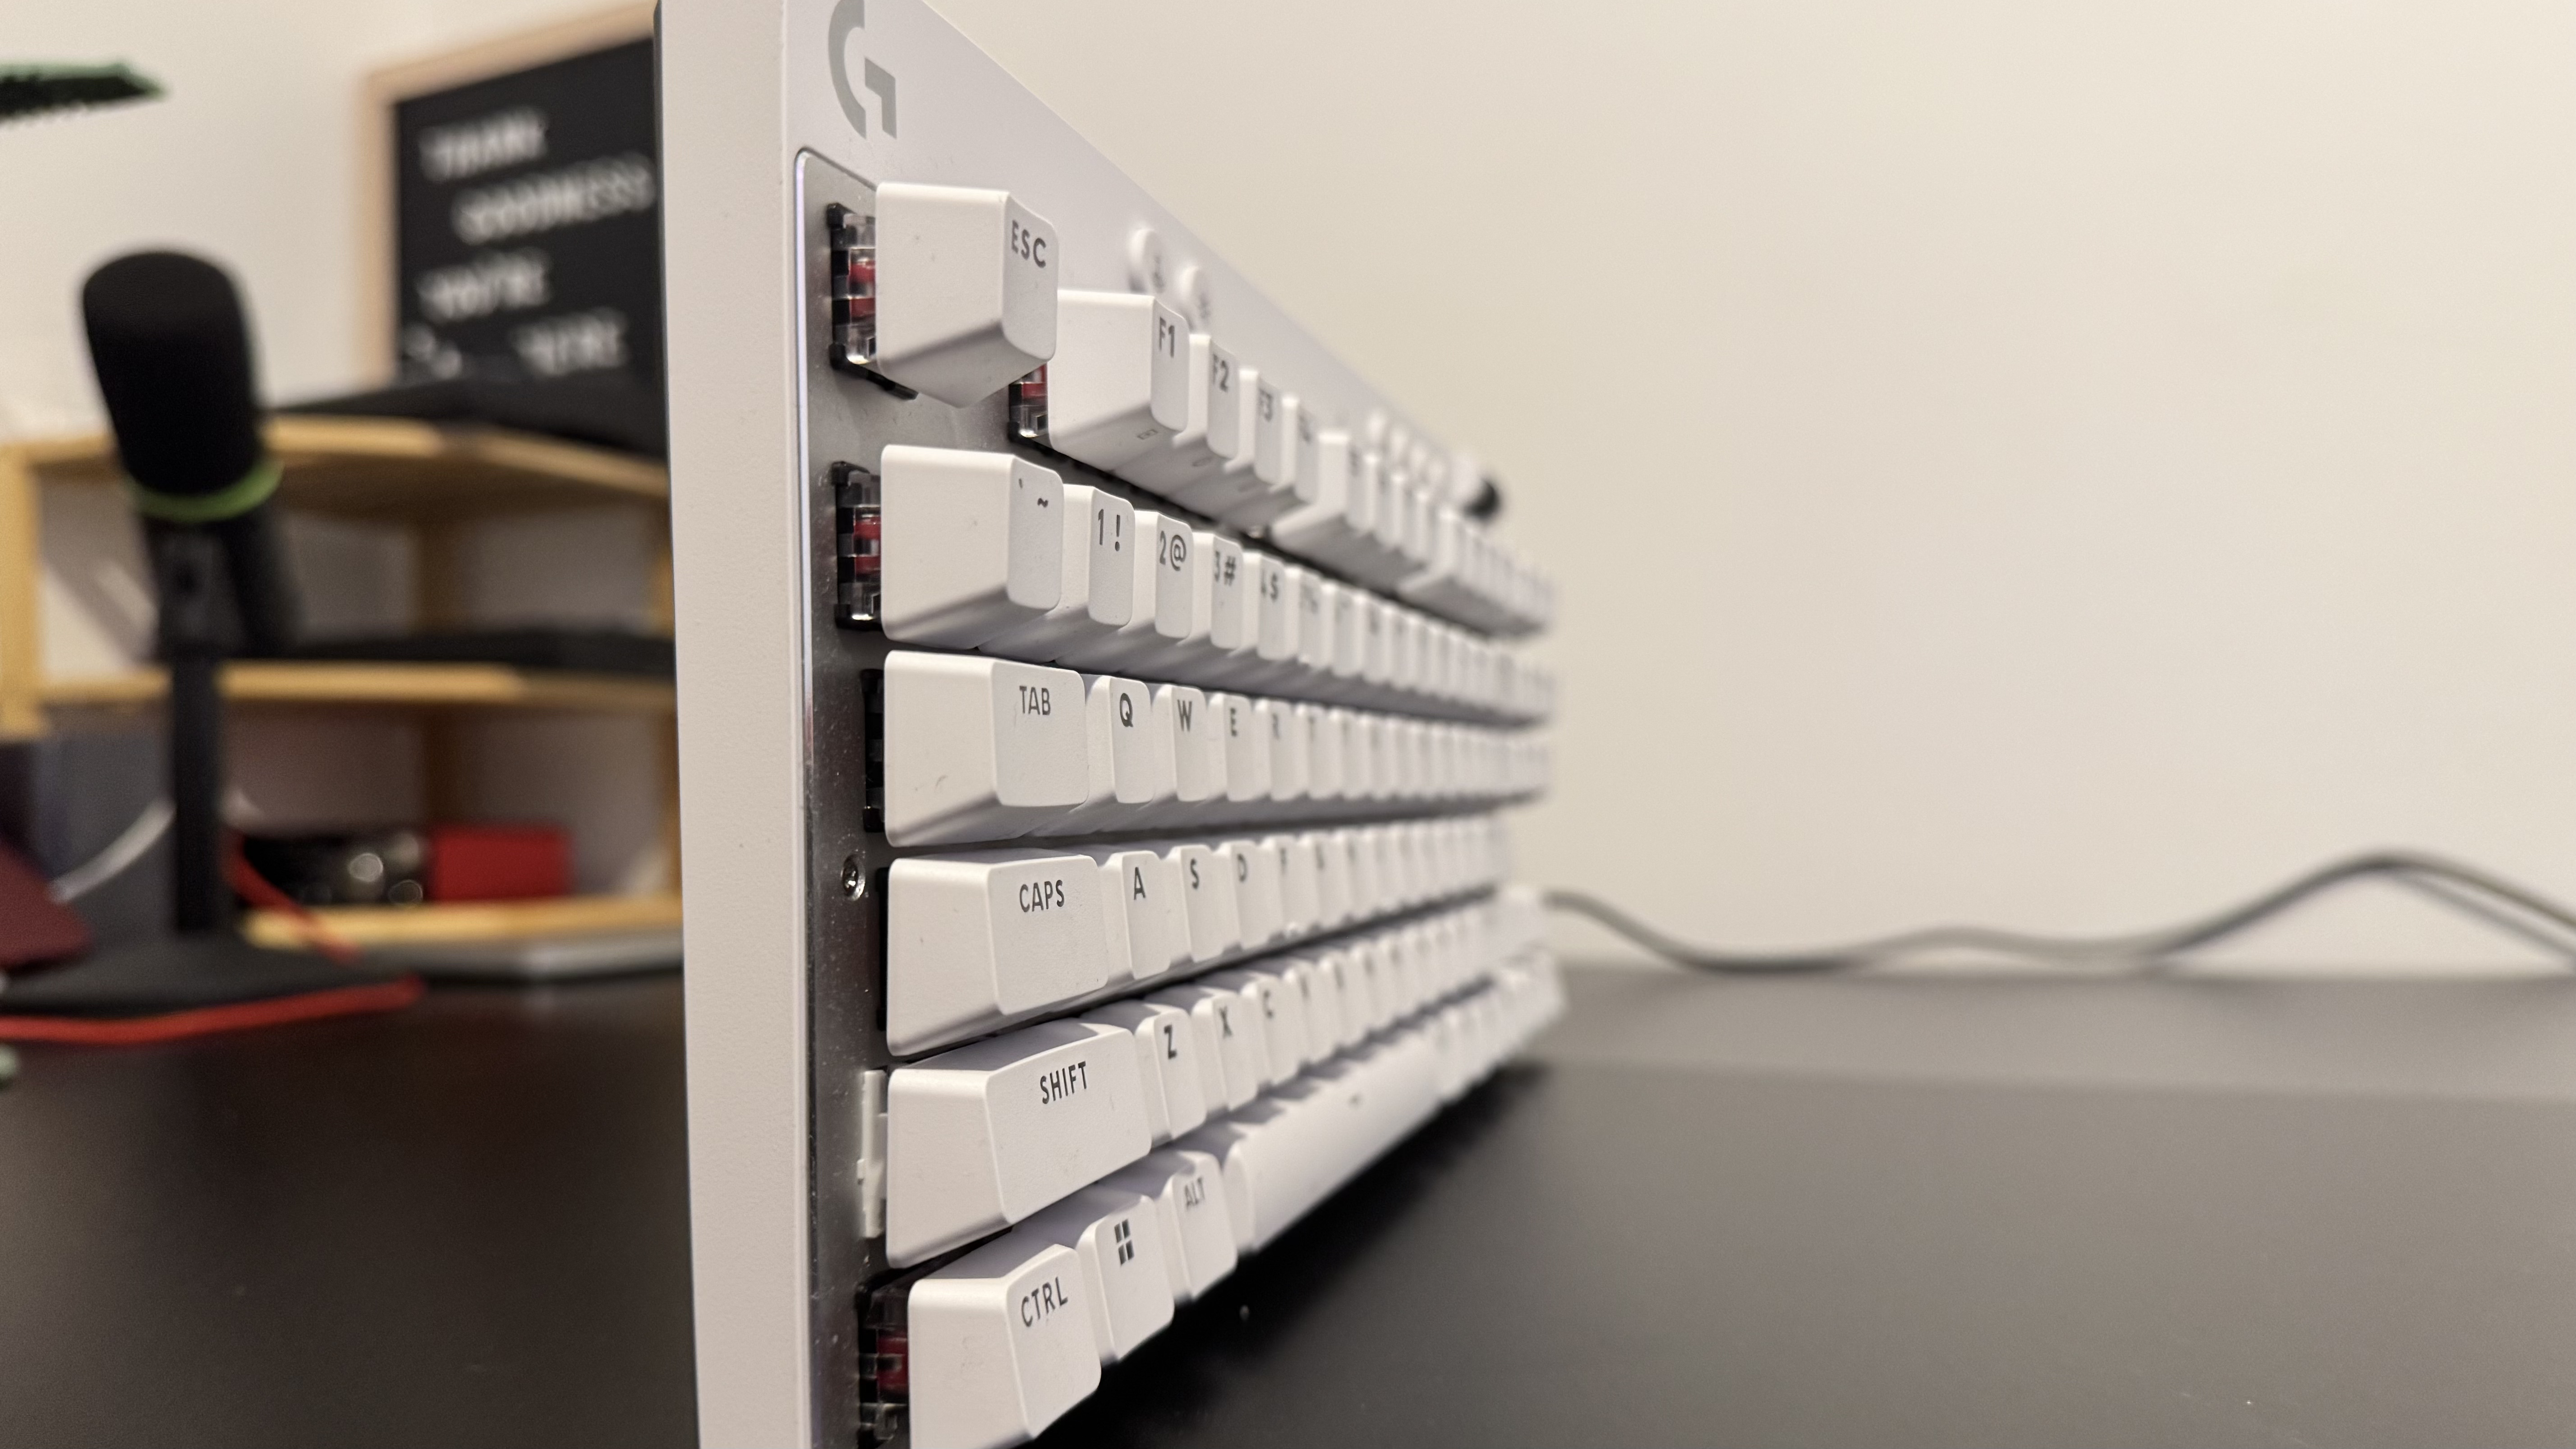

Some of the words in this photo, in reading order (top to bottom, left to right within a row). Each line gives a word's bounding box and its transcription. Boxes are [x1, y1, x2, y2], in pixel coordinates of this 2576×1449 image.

[1012, 220, 1046, 268] ESC
[1159, 317, 1175, 358] F1
[1213, 354, 1229, 393] F2
[1019, 685, 1051, 716] TAB
[1119, 693, 1134, 727] Q
[1177, 699, 1192, 732] W
[1230, 708, 1238, 737] E
[1133, 867, 1146, 900] A
[1190, 858, 1199, 890] S
[1019, 879, 1065, 913] CAPS
[1219, 1006, 1232, 1037] X
[1164, 1024, 1177, 1059] Z
[1040, 1061, 1087, 1104] SHIFT
[1184, 1177, 1205, 1210] ALT
[1021, 1276, 1069, 1328] CTRL
